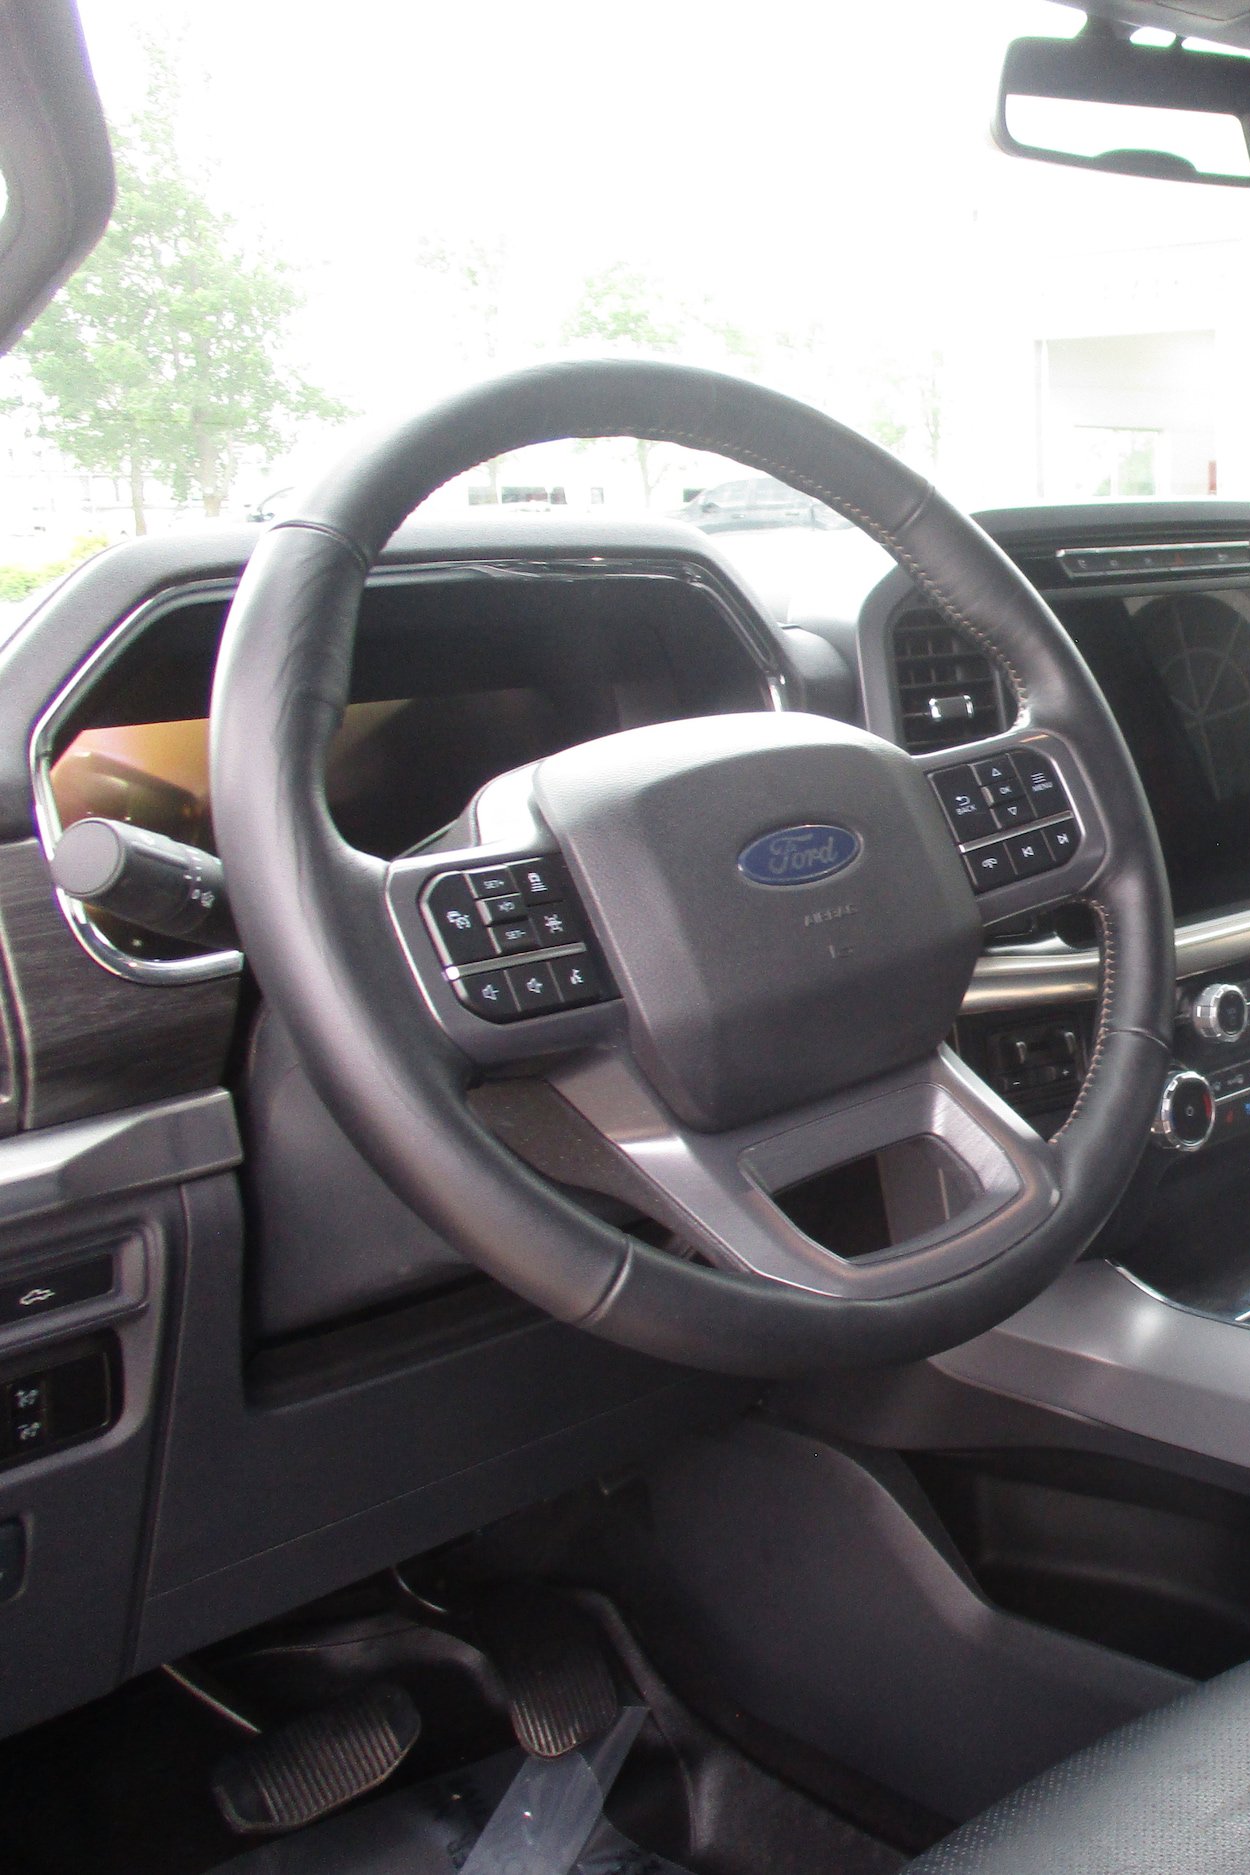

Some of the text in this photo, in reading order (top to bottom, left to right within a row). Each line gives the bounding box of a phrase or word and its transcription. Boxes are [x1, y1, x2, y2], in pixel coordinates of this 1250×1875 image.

[1000, 786, 1012, 795] OK
[956, 804, 977, 815] BACK
[768, 833, 839, 875] Ford
